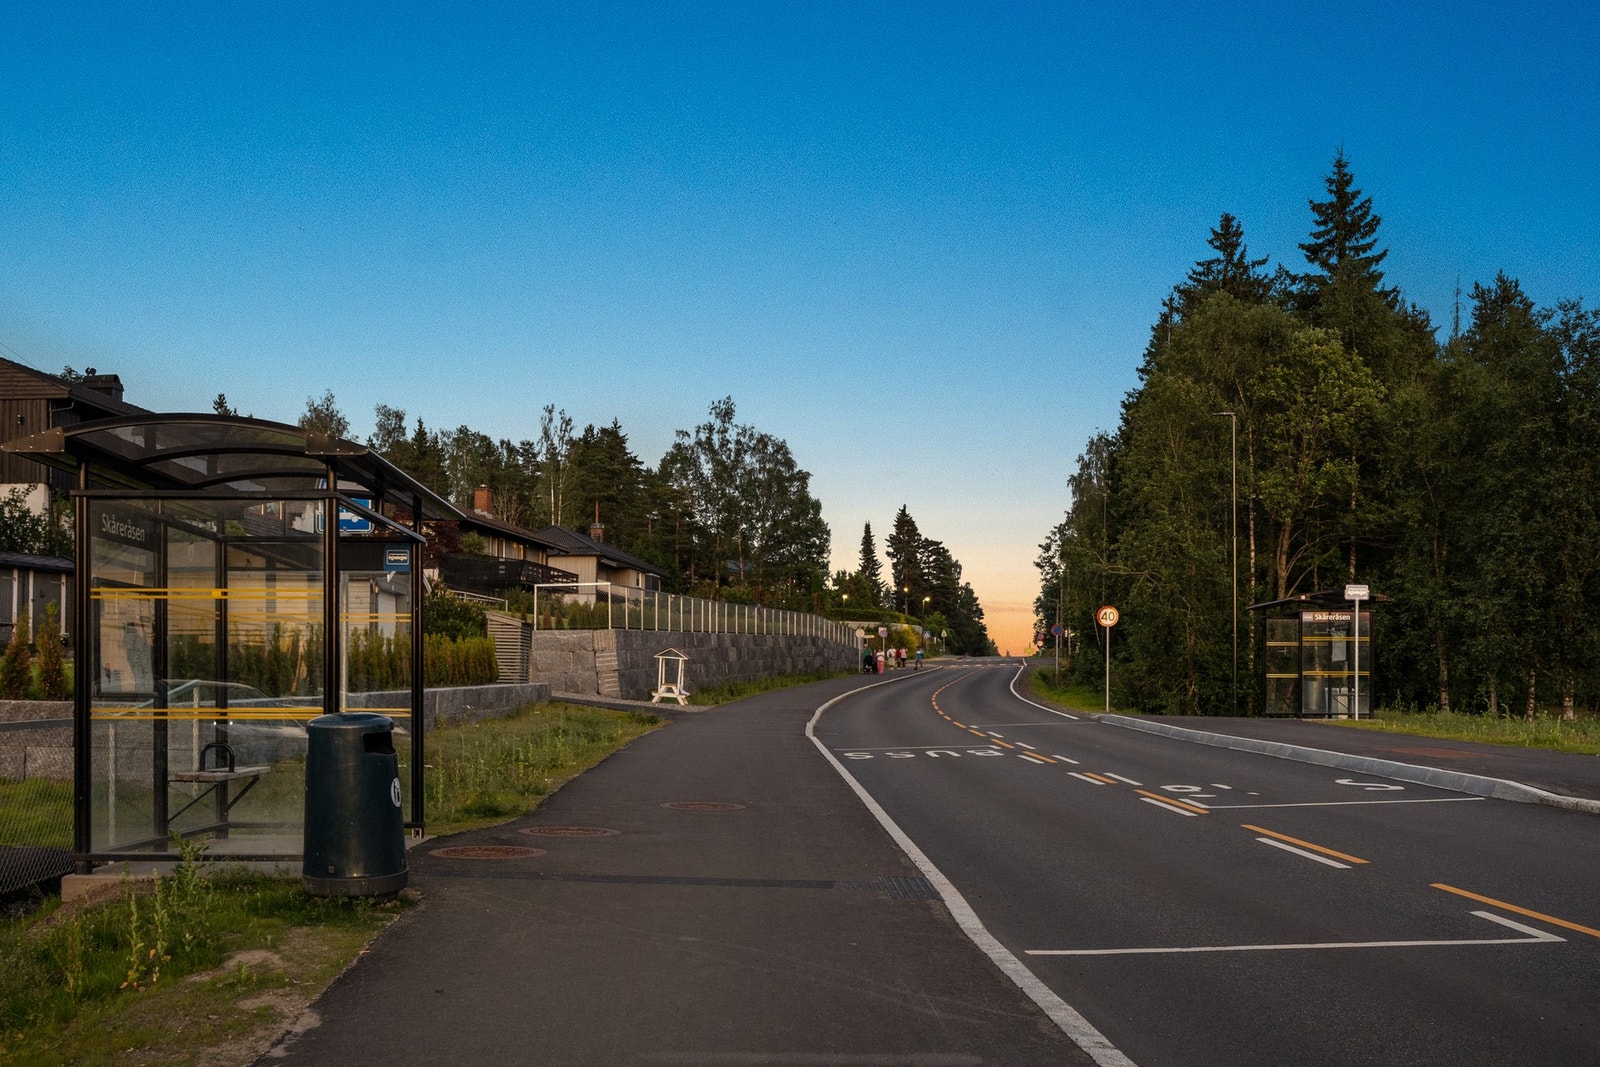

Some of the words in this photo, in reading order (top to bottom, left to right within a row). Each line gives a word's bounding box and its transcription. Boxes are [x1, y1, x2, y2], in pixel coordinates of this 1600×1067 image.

[102, 513, 145, 542] Skåreråsen
[1101, 611, 1115, 621] 40
[1314, 612, 1351, 621] Skåreråsen
